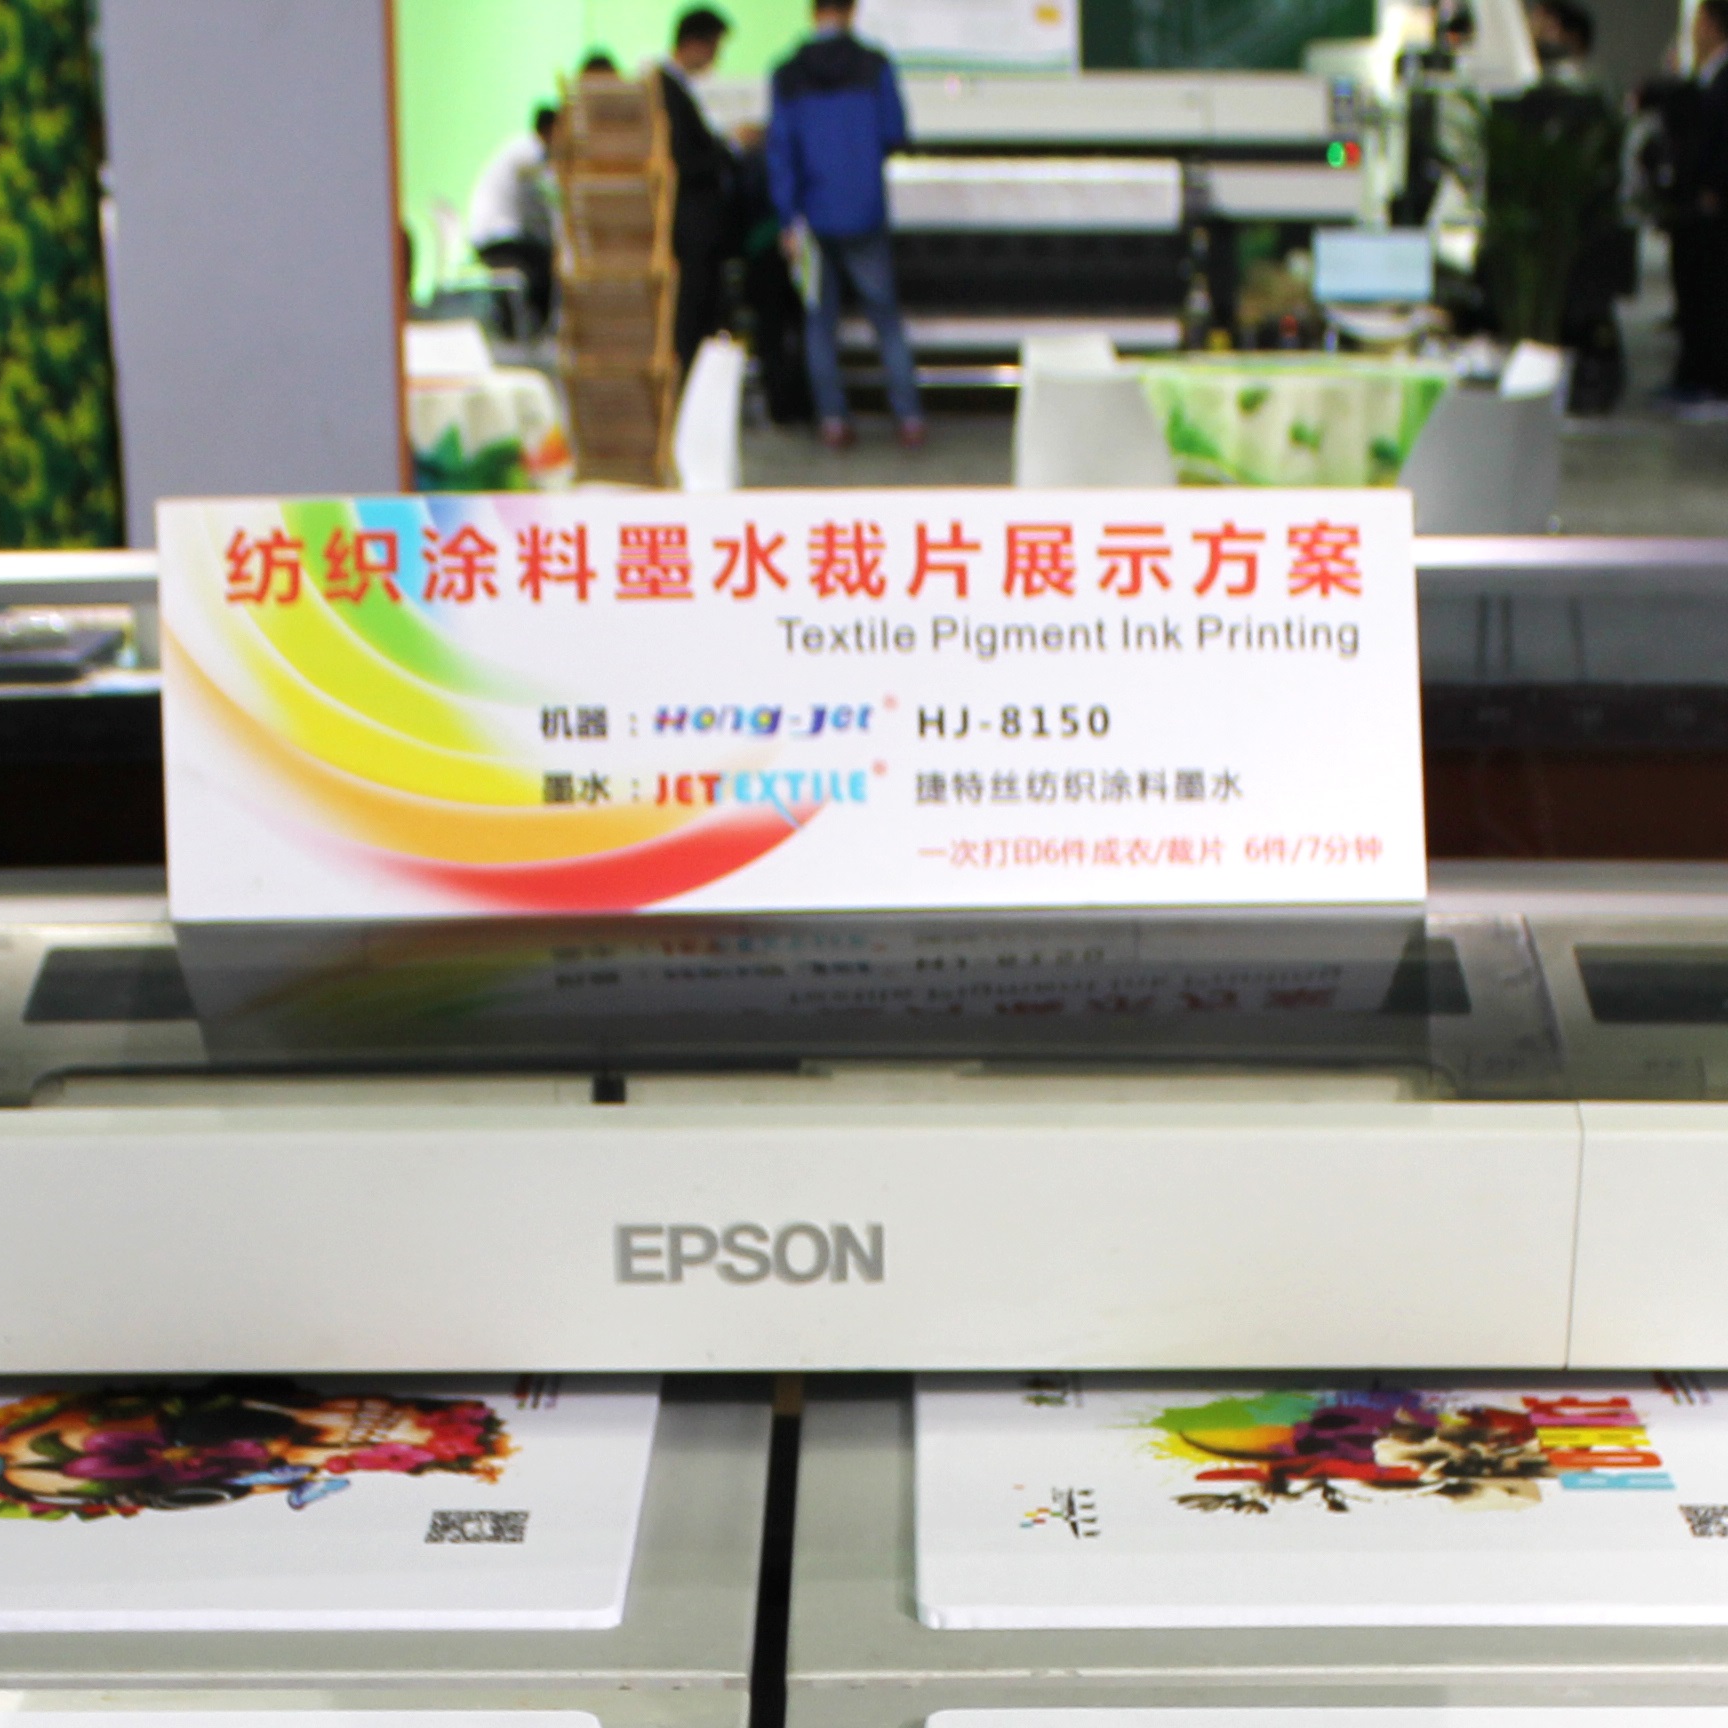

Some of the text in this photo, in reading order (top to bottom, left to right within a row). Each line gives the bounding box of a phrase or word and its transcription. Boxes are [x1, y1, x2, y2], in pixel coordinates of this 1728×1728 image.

[224, 521, 1364, 606] 纺织涂料墨水裁片展示方案
[776, 614, 1360, 661] Textile Pigment Ink Printing
[917, 706, 1111, 738] HJ-8150
[916, 768, 1244, 804] 捷特丝纺织涂料墨水
[615, 1222, 885, 1285] EPSON
